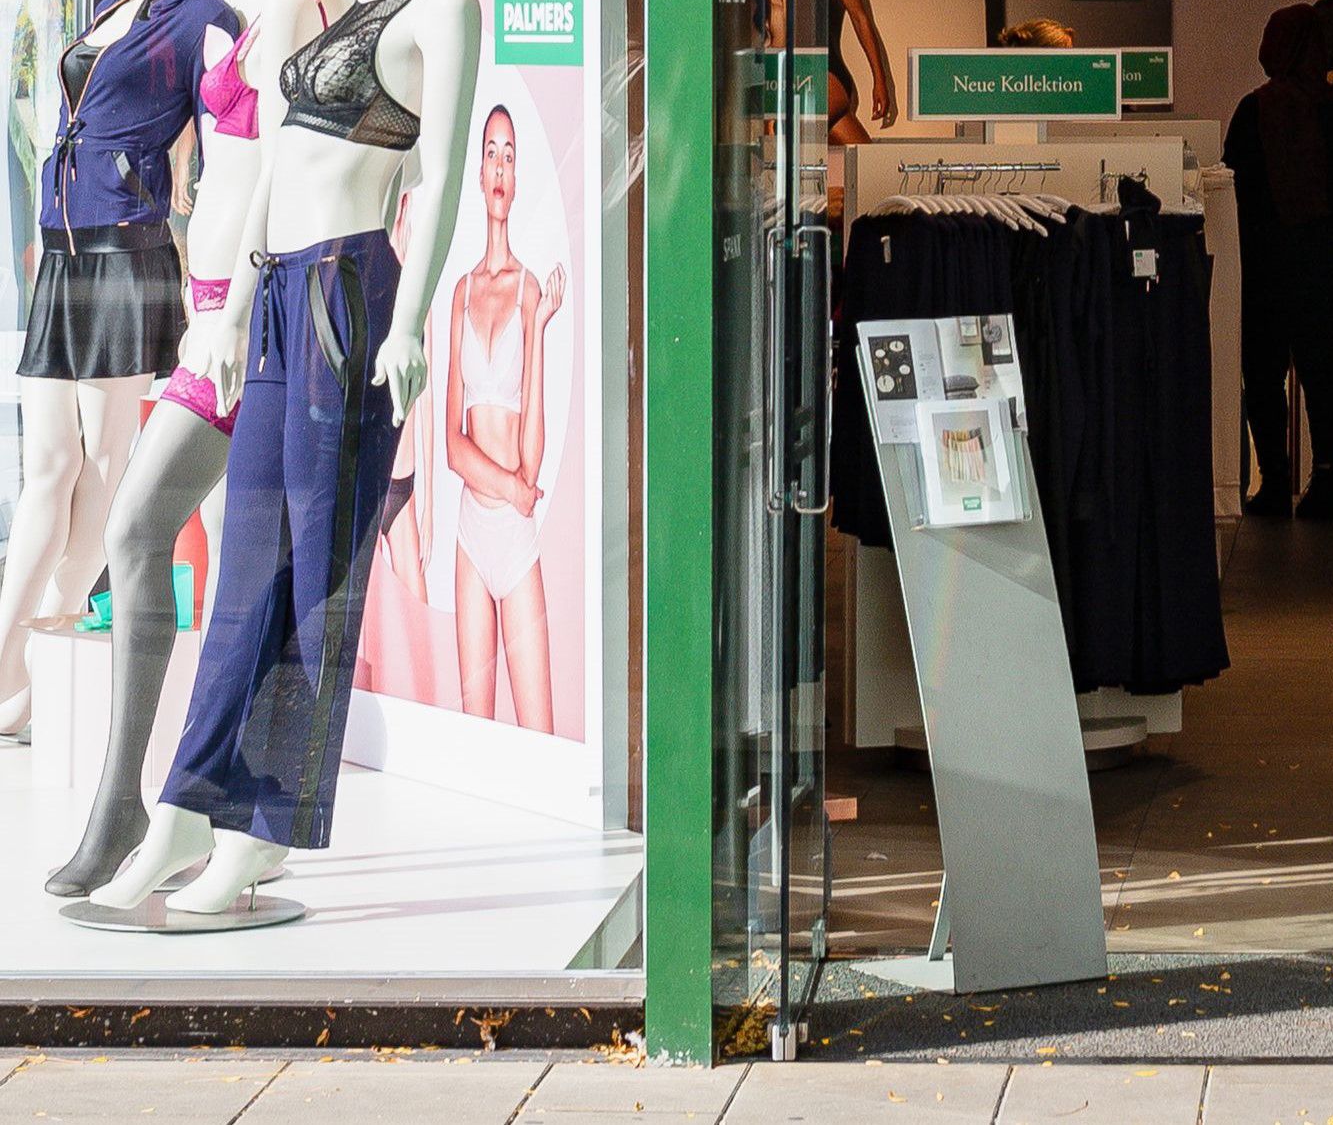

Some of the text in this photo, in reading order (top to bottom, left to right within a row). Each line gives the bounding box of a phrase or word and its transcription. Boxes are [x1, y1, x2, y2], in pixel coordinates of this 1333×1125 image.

[503, 1, 575, 33] PALMERS
[953, 74, 1084, 94] Neue Kollektion
